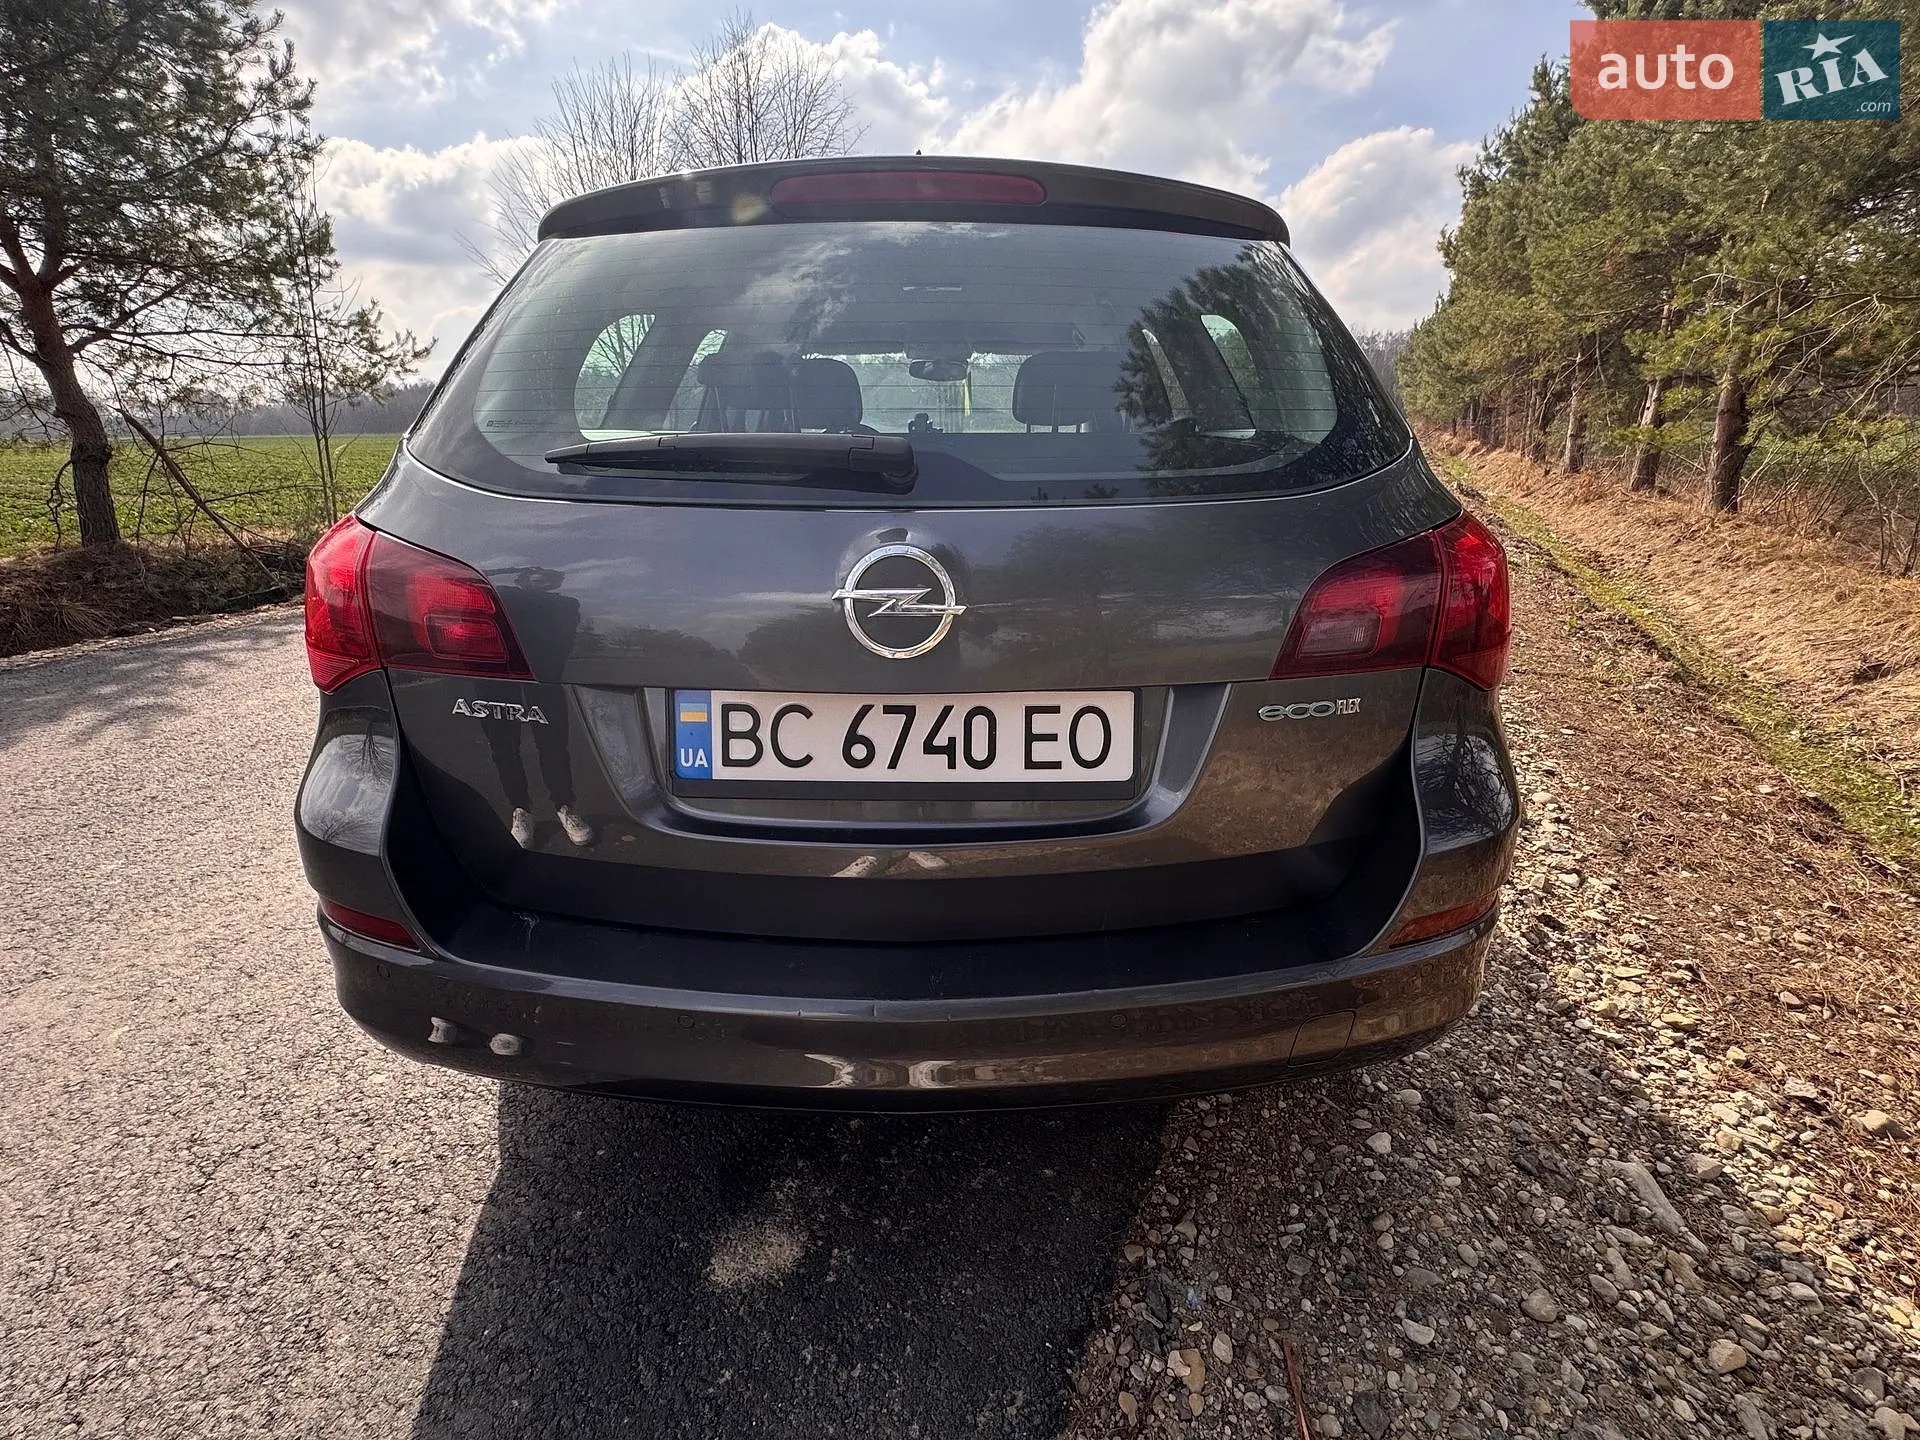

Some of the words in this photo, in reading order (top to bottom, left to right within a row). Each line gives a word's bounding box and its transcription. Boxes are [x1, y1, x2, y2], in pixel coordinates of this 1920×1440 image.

[452, 698, 549, 725] ASTRA
[721, 703, 814, 768] BC
[841, 704, 998, 770] 6740
[1023, 705, 1112, 770] EO
[680, 748, 708, 768] UA
